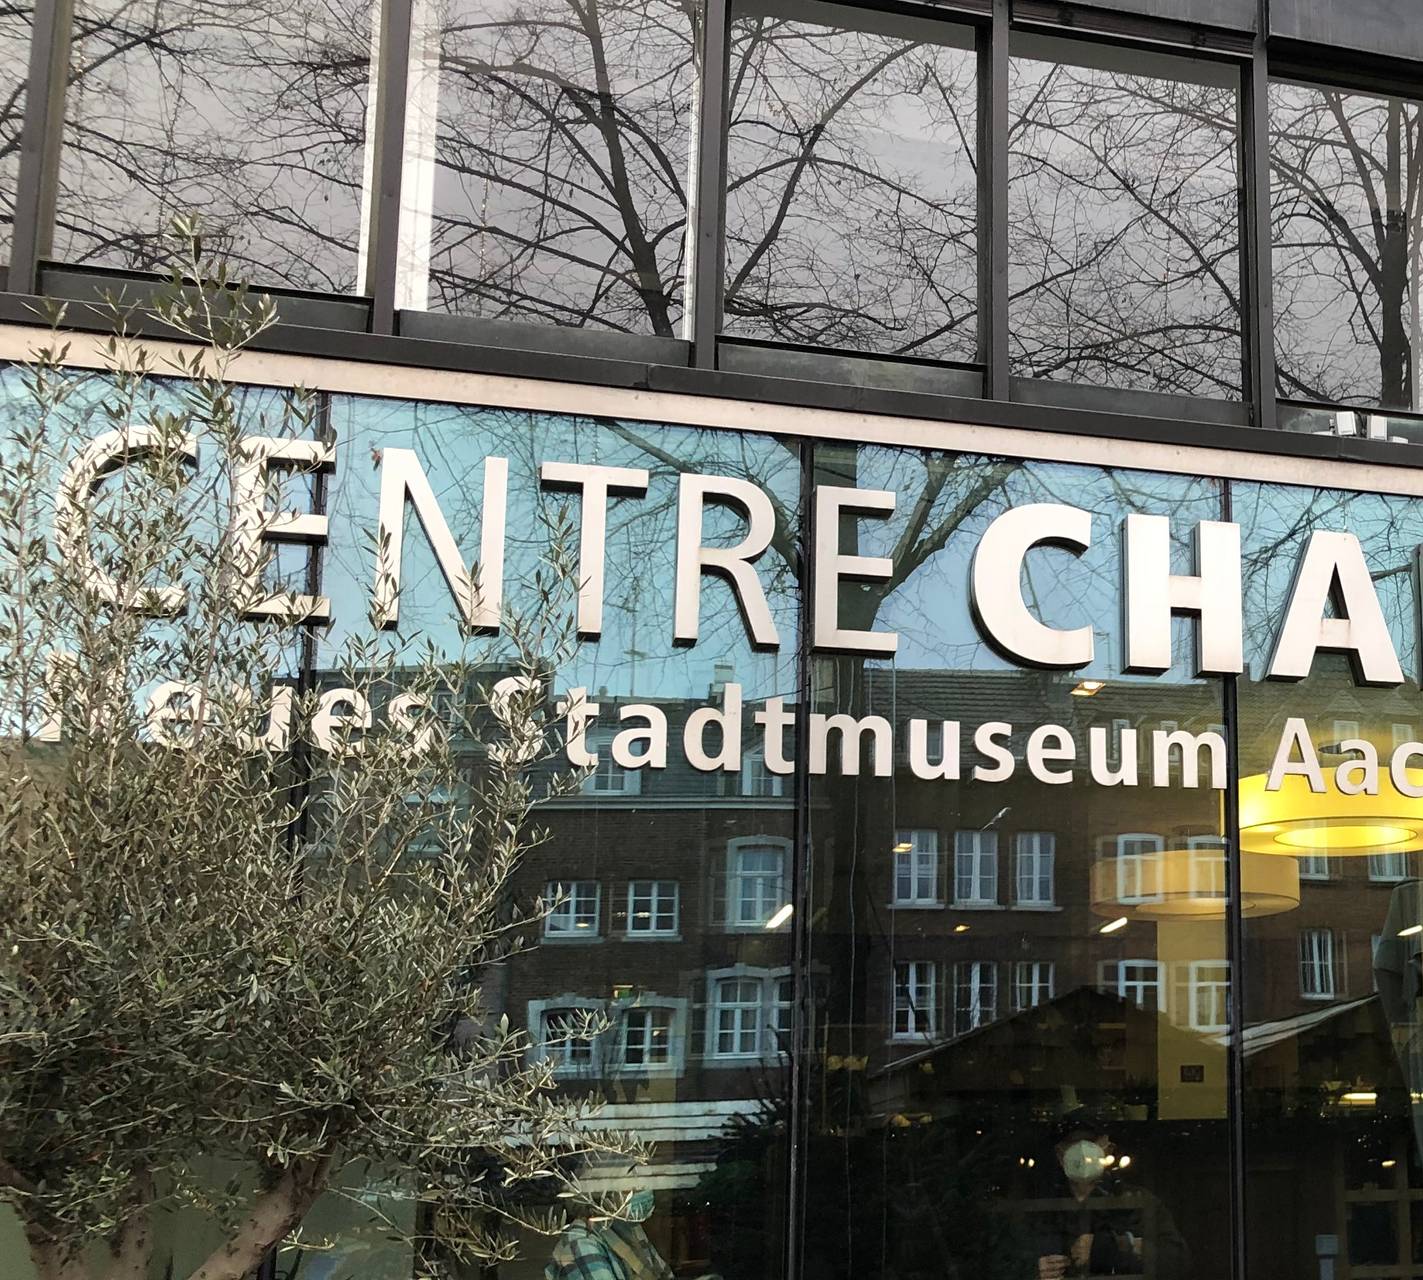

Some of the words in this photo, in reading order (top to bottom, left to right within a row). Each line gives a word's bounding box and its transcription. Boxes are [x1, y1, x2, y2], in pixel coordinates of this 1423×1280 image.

[54, 424, 897, 660] CENTRE
[40, 650, 435, 762] eues
[487, 674, 1228, 790] Stadtmuseum
